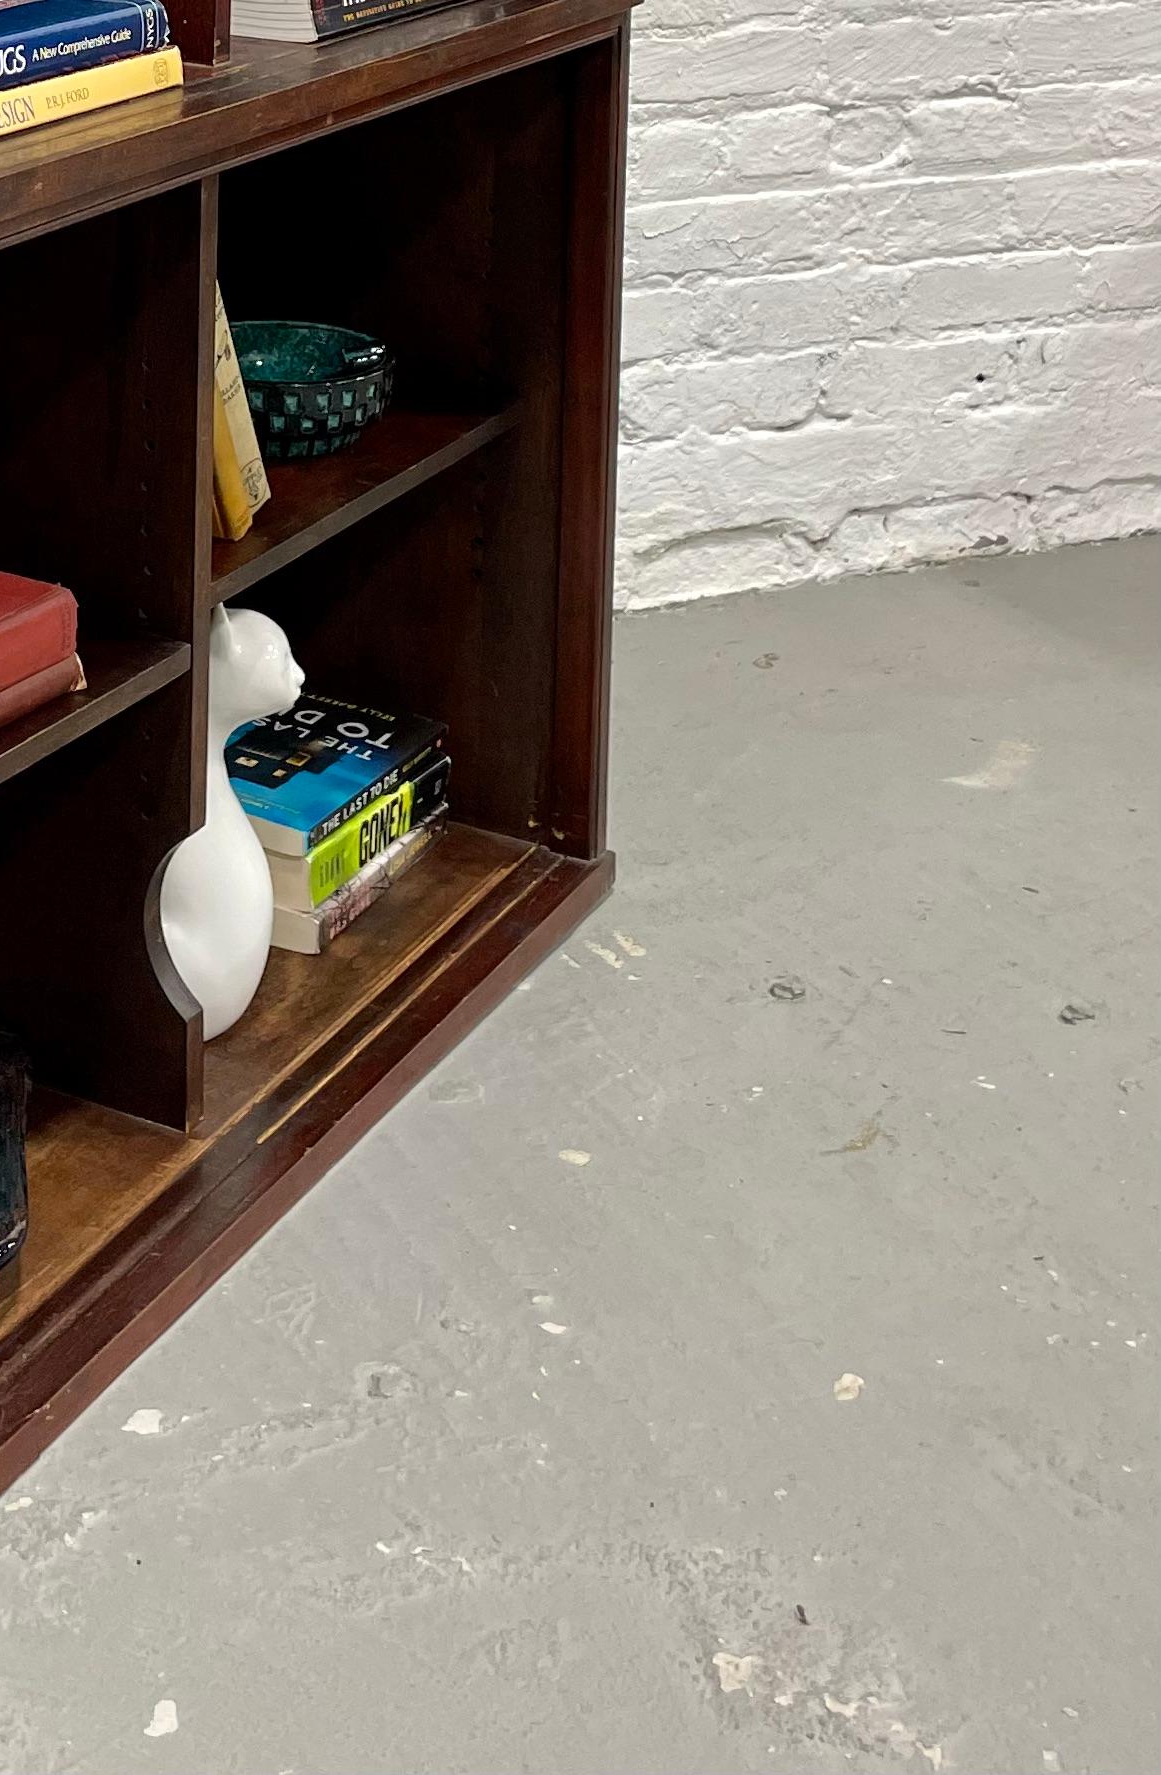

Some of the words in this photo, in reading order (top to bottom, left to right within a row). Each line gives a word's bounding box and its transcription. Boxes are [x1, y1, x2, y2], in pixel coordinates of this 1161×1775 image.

[145, 8, 155, 48] NYGS
[32, 49, 40, 62] A
[40, 46, 58, 60] New
[58, 33, 111, 56] Comprehensive
[111, 27, 132, 43] Guide
[66, 87, 90, 106] FORD
[252, 716, 312, 739] LAS
[336, 722, 396, 750] TO
[324, 735, 374, 761] THE
[322, 812, 341, 837] THE
[343, 793, 369, 820] LAST
[369, 782, 383, 800] TO
[383, 768, 400, 789] DIE
[359, 797, 400, 869] GONE
